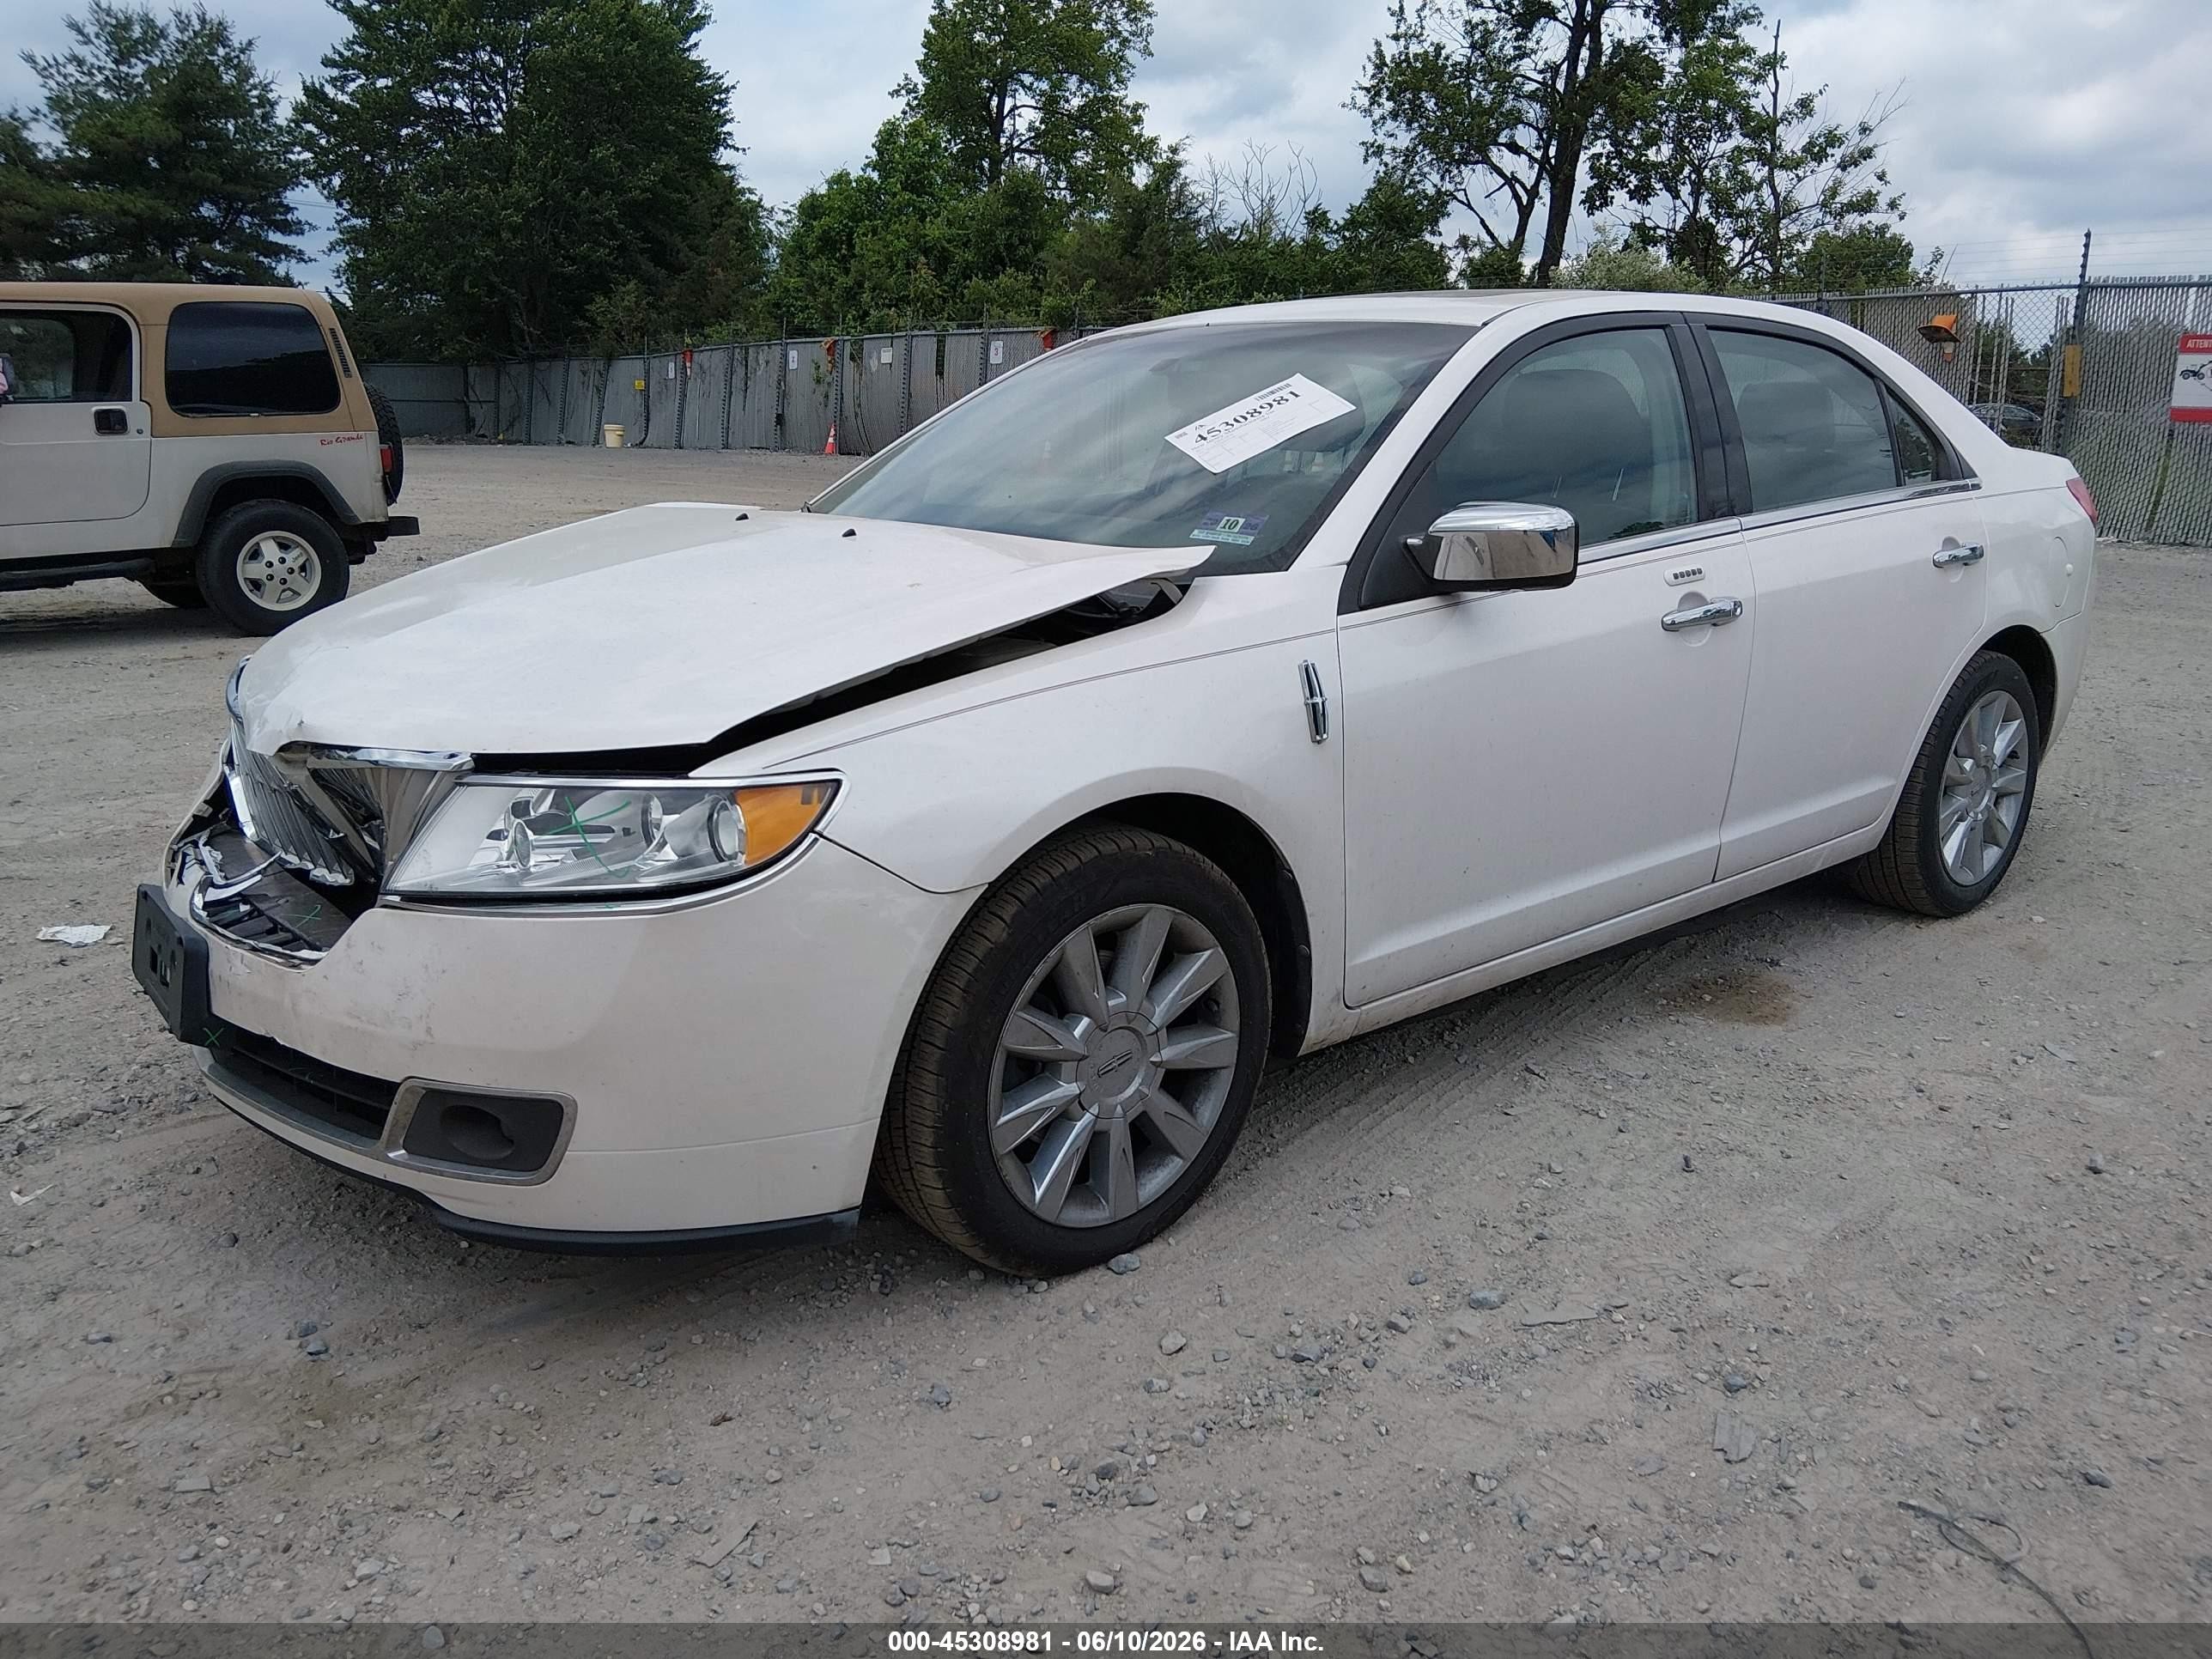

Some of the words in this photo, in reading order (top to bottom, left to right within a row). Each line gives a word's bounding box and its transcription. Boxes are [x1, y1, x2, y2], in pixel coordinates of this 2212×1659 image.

[1194, 390, 1302, 444] 45308981
[335, 433, 363, 444] Grande
[1219, 518, 1240, 531] 10
